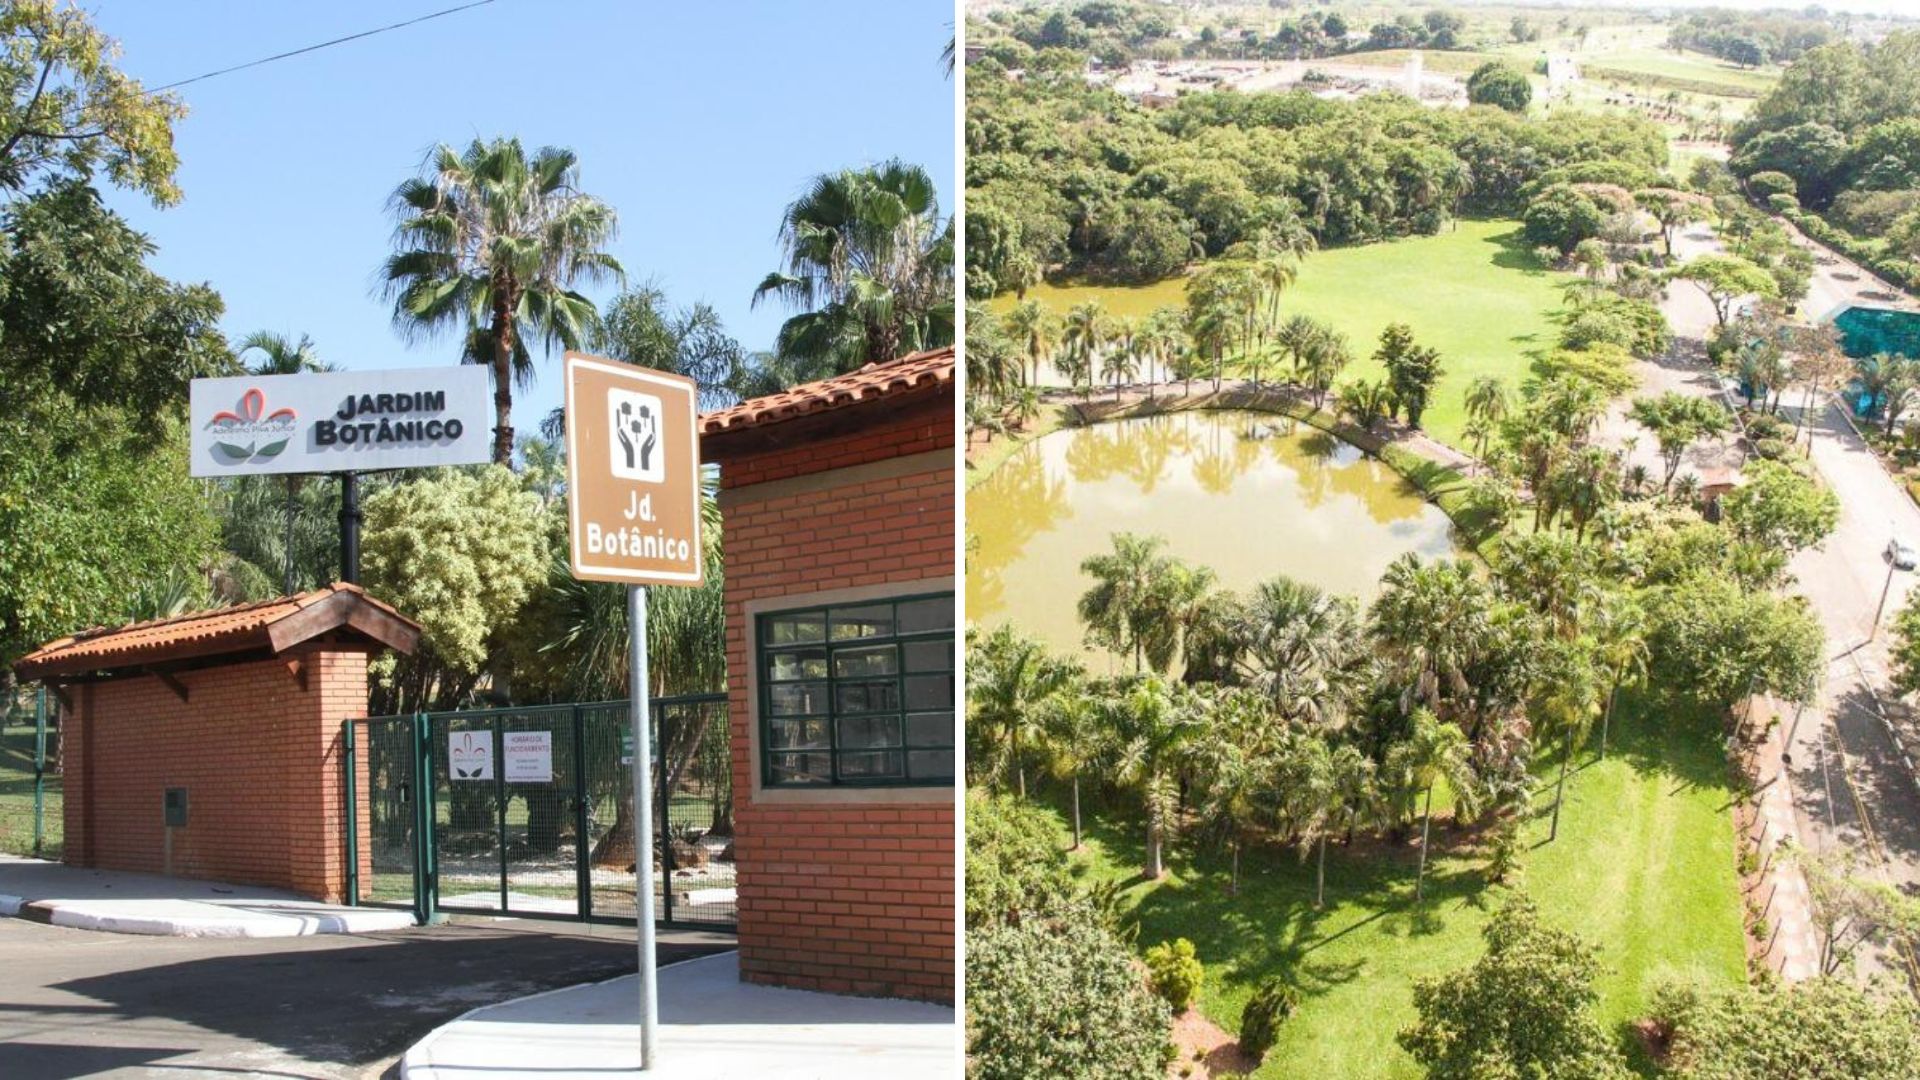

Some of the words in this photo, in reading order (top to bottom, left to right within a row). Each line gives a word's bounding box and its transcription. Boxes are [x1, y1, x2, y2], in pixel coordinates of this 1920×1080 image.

[336, 390, 445, 420] JARDIM
[623, 489, 656, 522] Jd.
[587, 522, 689, 561] Botânico
